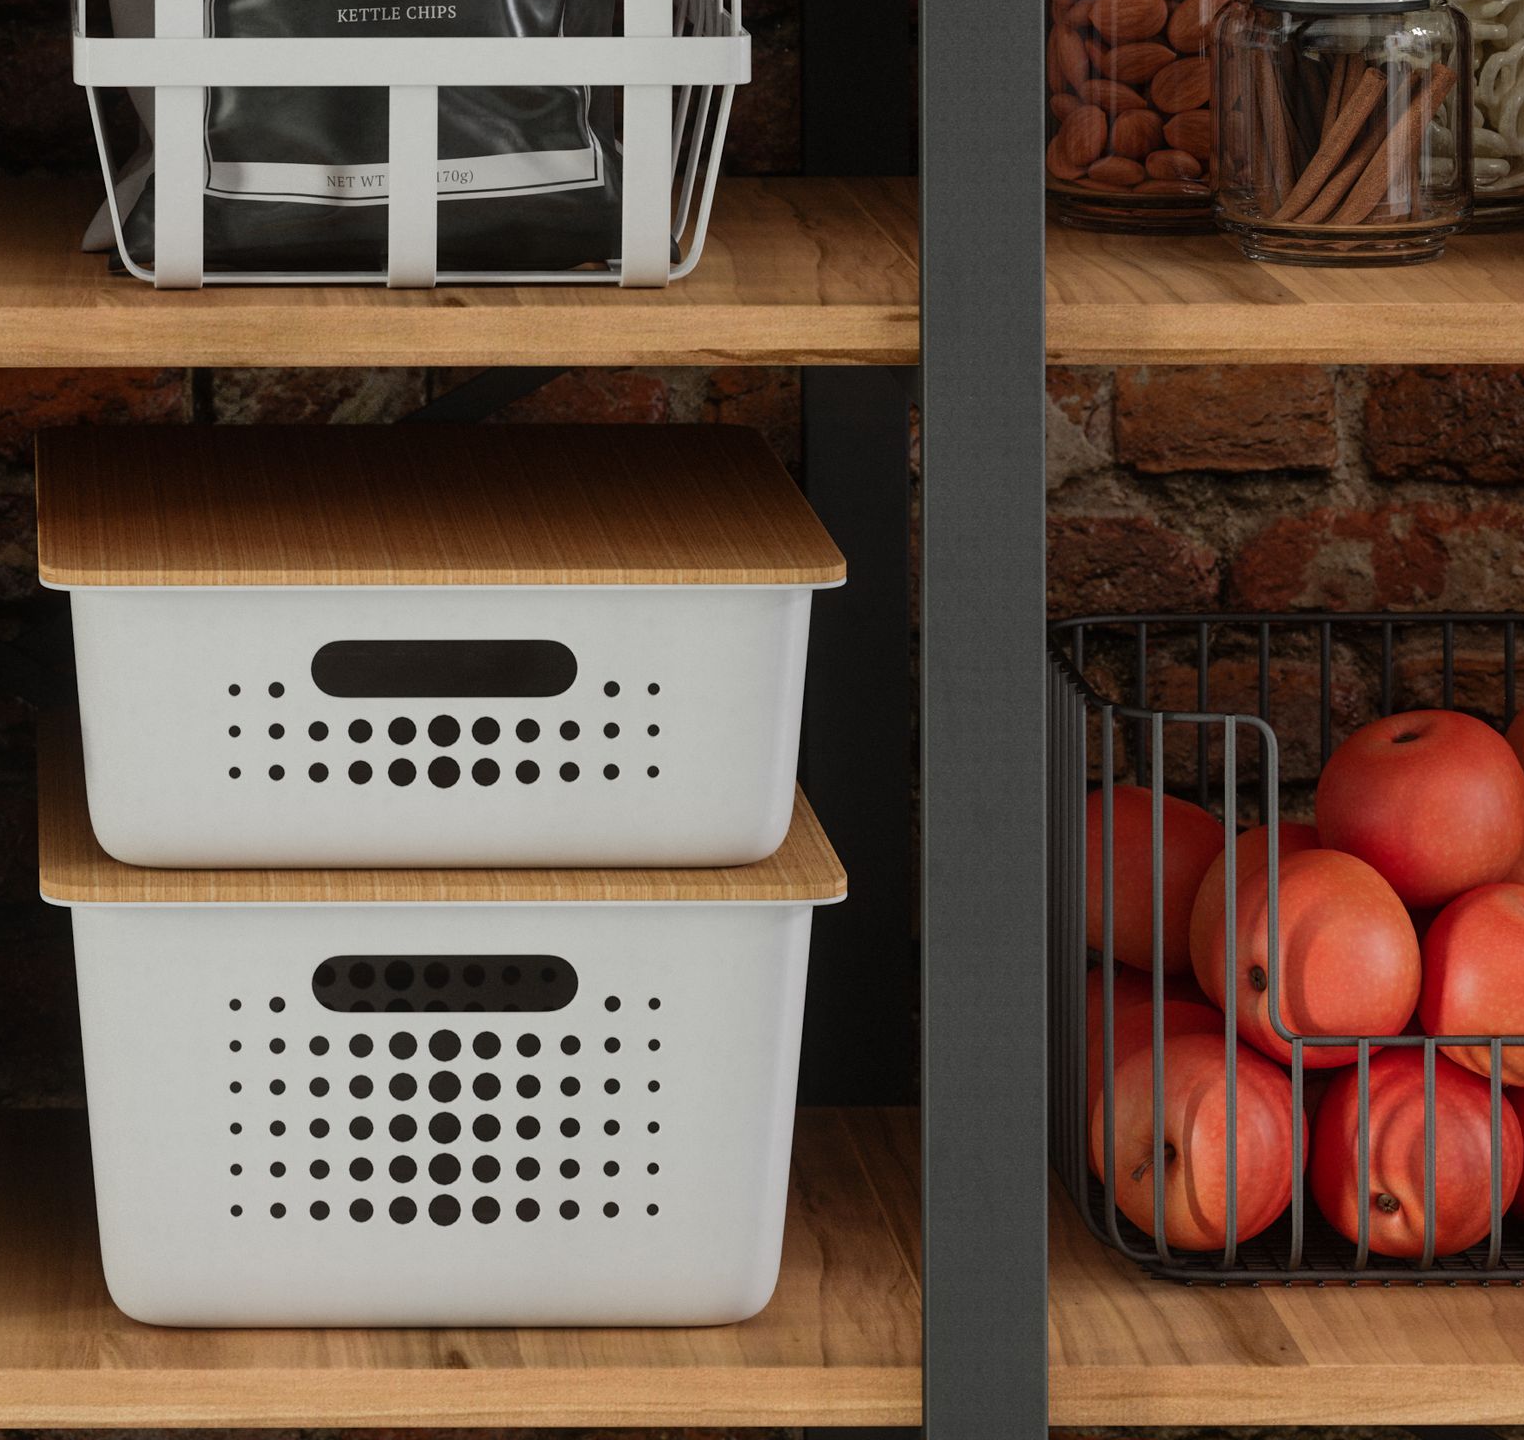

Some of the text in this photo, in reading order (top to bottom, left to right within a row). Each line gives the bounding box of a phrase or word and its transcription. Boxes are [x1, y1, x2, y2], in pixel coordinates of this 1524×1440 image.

[337, 5, 457, 23] KETTLE CHIPS
[327, 169, 474, 188] NET WT 170g)
